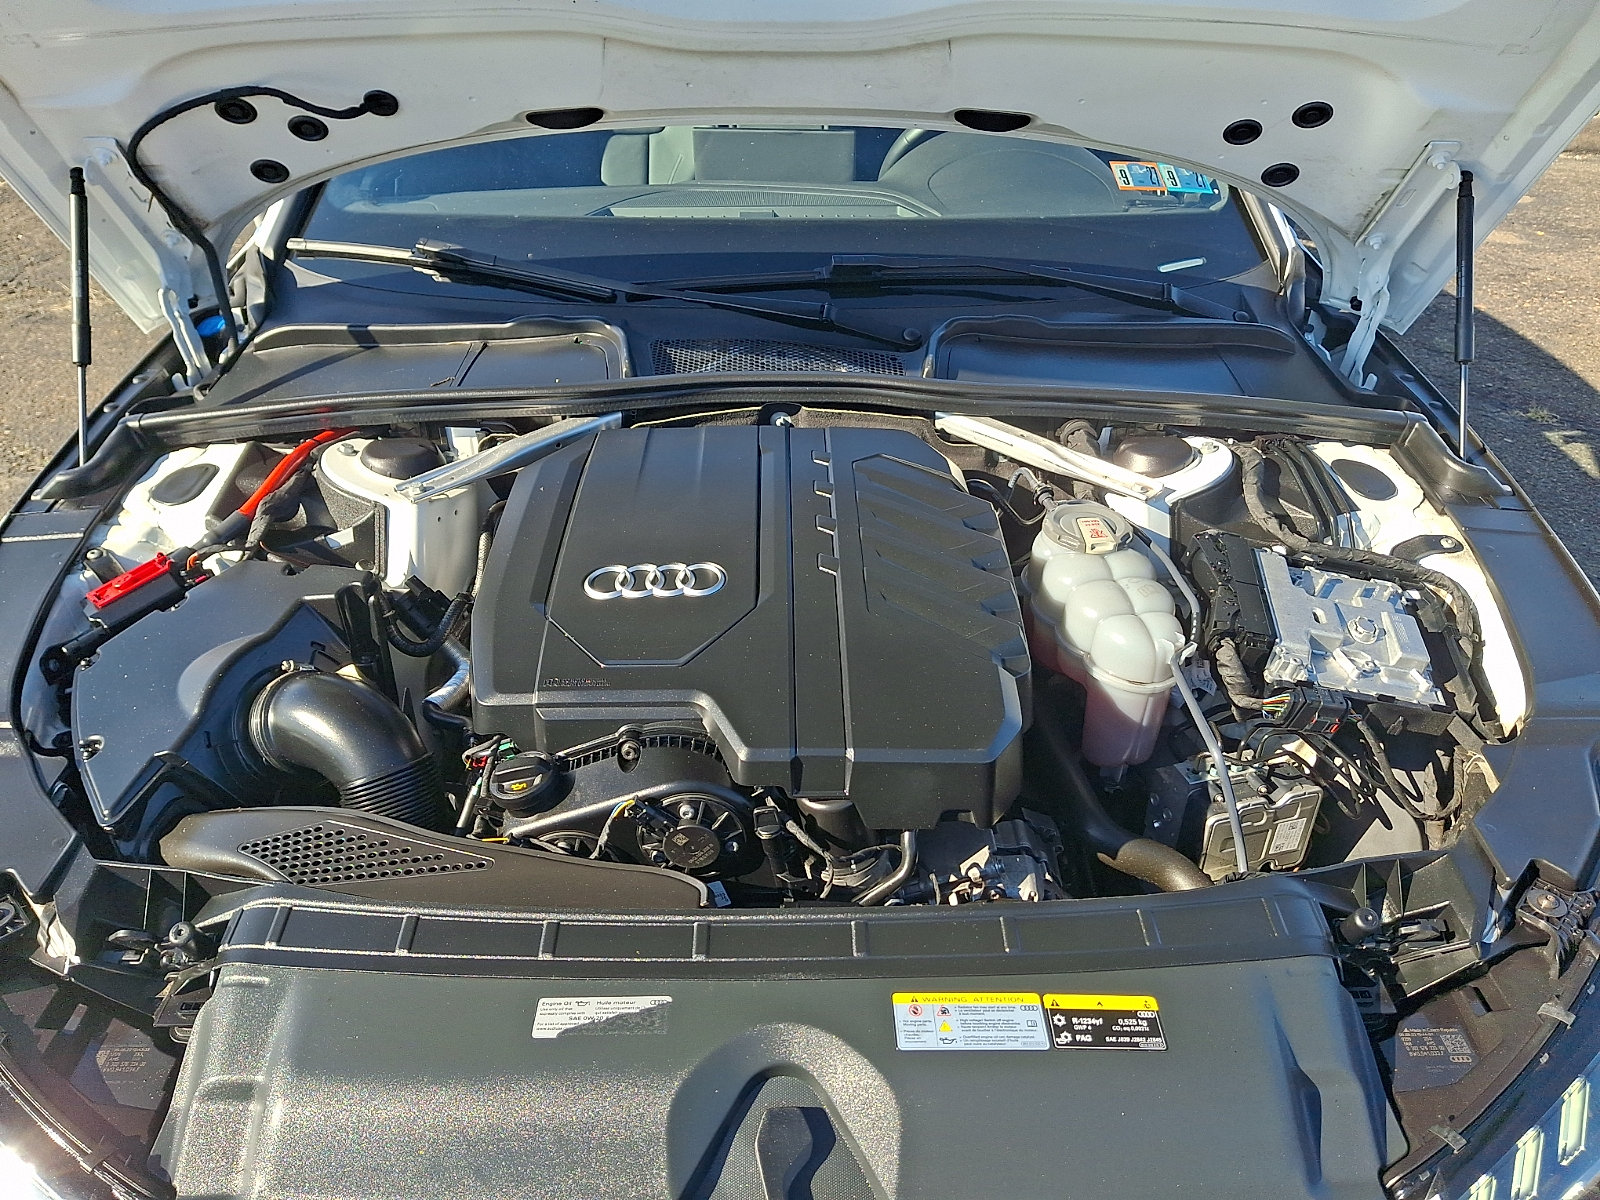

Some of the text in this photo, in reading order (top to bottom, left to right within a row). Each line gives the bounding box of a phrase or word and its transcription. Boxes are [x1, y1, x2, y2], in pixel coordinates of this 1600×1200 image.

[1119, 169, 1130, 186] 9
[1166, 170, 1178, 187] 9
[1117, 1018, 1137, 1026] 0,525
[1137, 1018, 1148, 1026] kg
[1075, 1034, 1093, 1042] PAG
